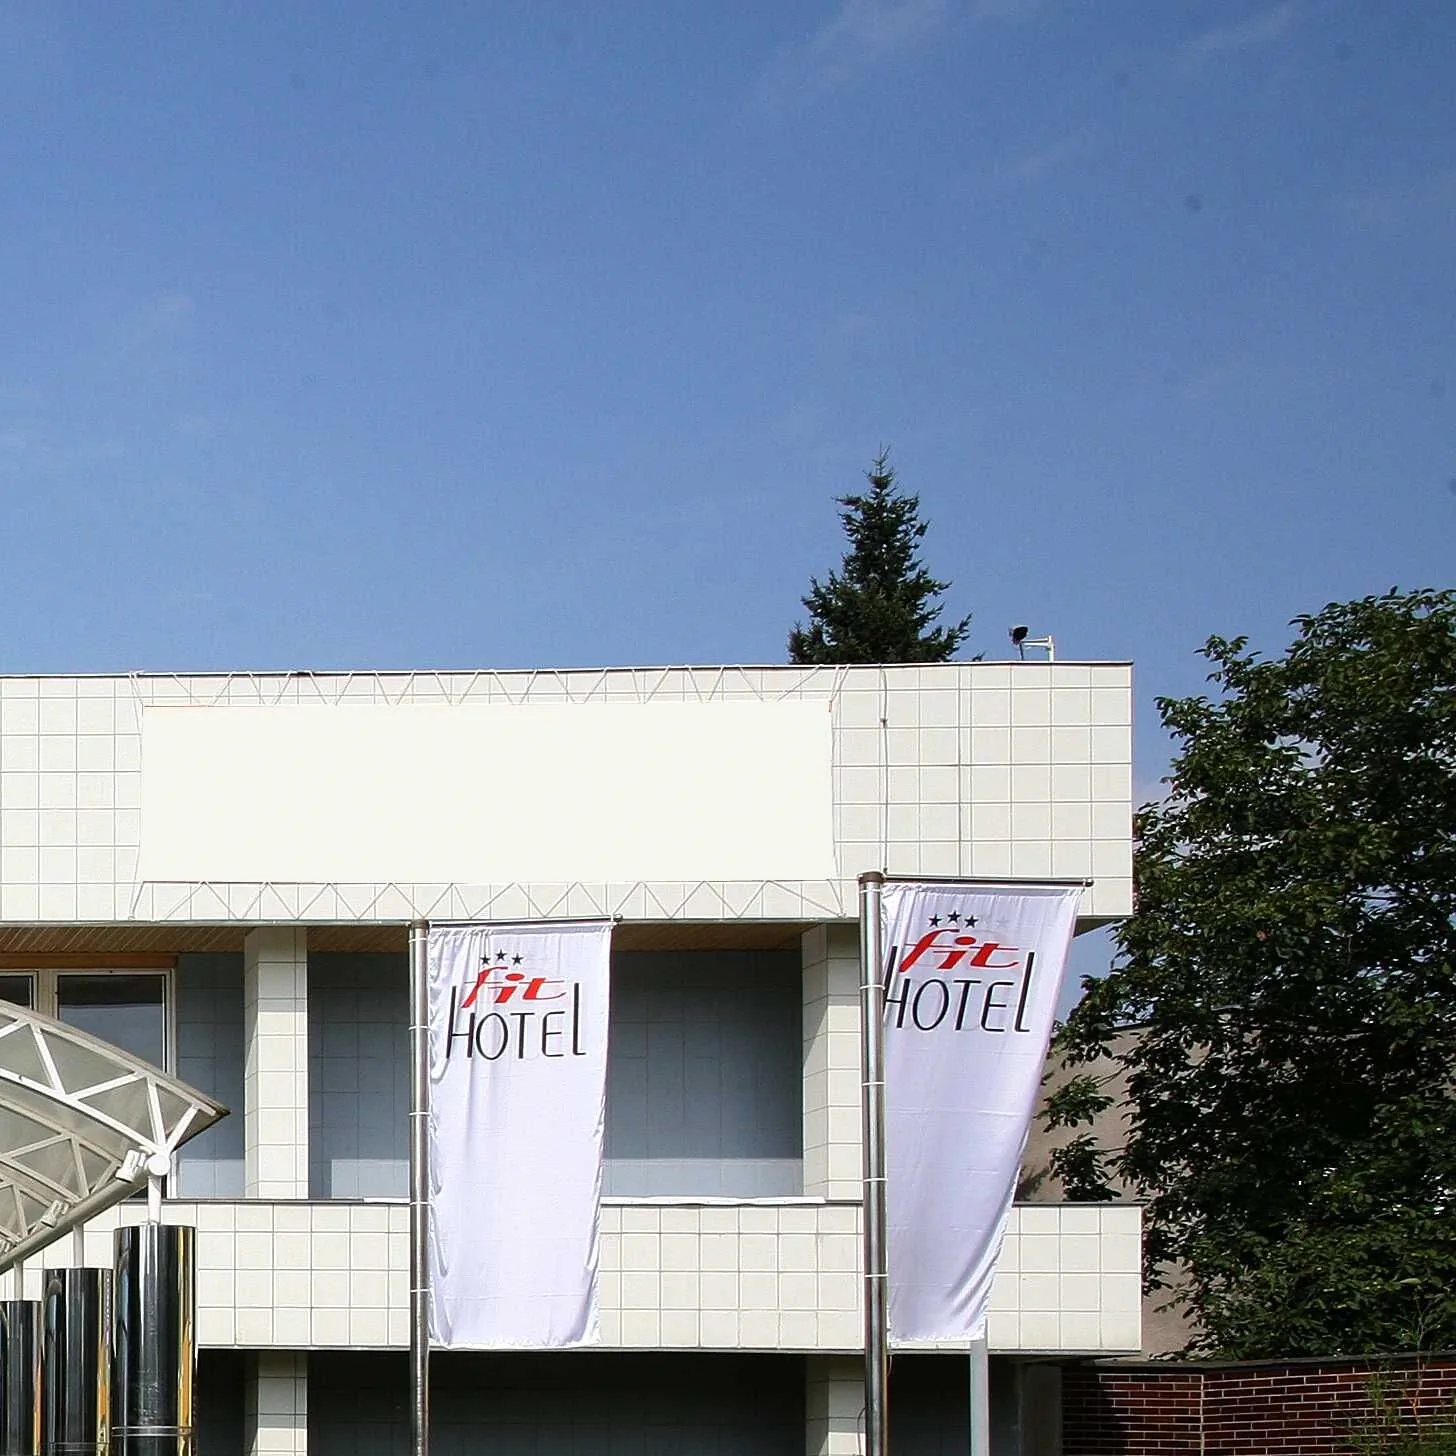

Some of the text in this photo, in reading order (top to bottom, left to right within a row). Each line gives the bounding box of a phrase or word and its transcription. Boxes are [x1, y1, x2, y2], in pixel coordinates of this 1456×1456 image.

[899, 928, 1020, 973] fit
[461, 966, 567, 1009] fit
[883, 945, 1036, 1033] HOTEL
[446, 982, 587, 1061] HOTEL
